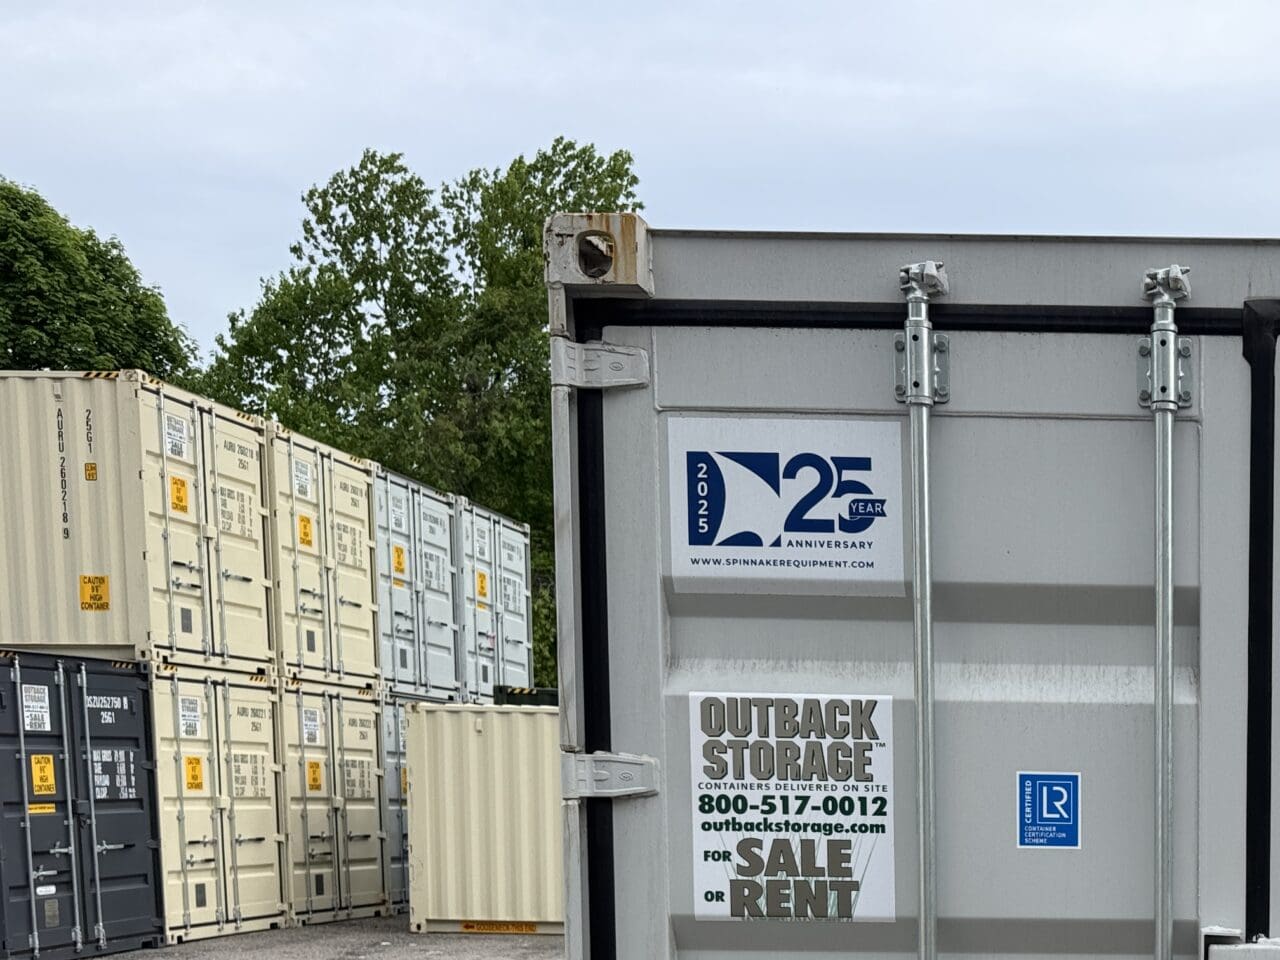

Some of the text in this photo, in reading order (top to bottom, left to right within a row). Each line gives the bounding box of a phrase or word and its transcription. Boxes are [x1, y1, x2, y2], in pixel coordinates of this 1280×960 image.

[57, 408, 65, 453] AURU
[60, 457, 68, 523] 260218
[697, 463, 709, 533] 2025
[782, 452, 876, 533] 25
[851, 502, 883, 513] YEAR
[690, 557, 875, 569] WWW.SPINNAKEREQUIPMENT.COM
[786, 539, 874, 550] ANNIVERSARY
[700, 696, 880, 741] OUTBACK
[702, 739, 874, 783] STORAGE
[698, 782, 888, 793] CONTAINERS DELIVERED ON SITE
[698, 794, 887, 817] 800-517-0012
[1043, 786, 1069, 818] LR
[701, 817, 886, 836] outbackstorage.com
[703, 837, 853, 878] FOR SALE
[704, 879, 860, 919] OR RENT
